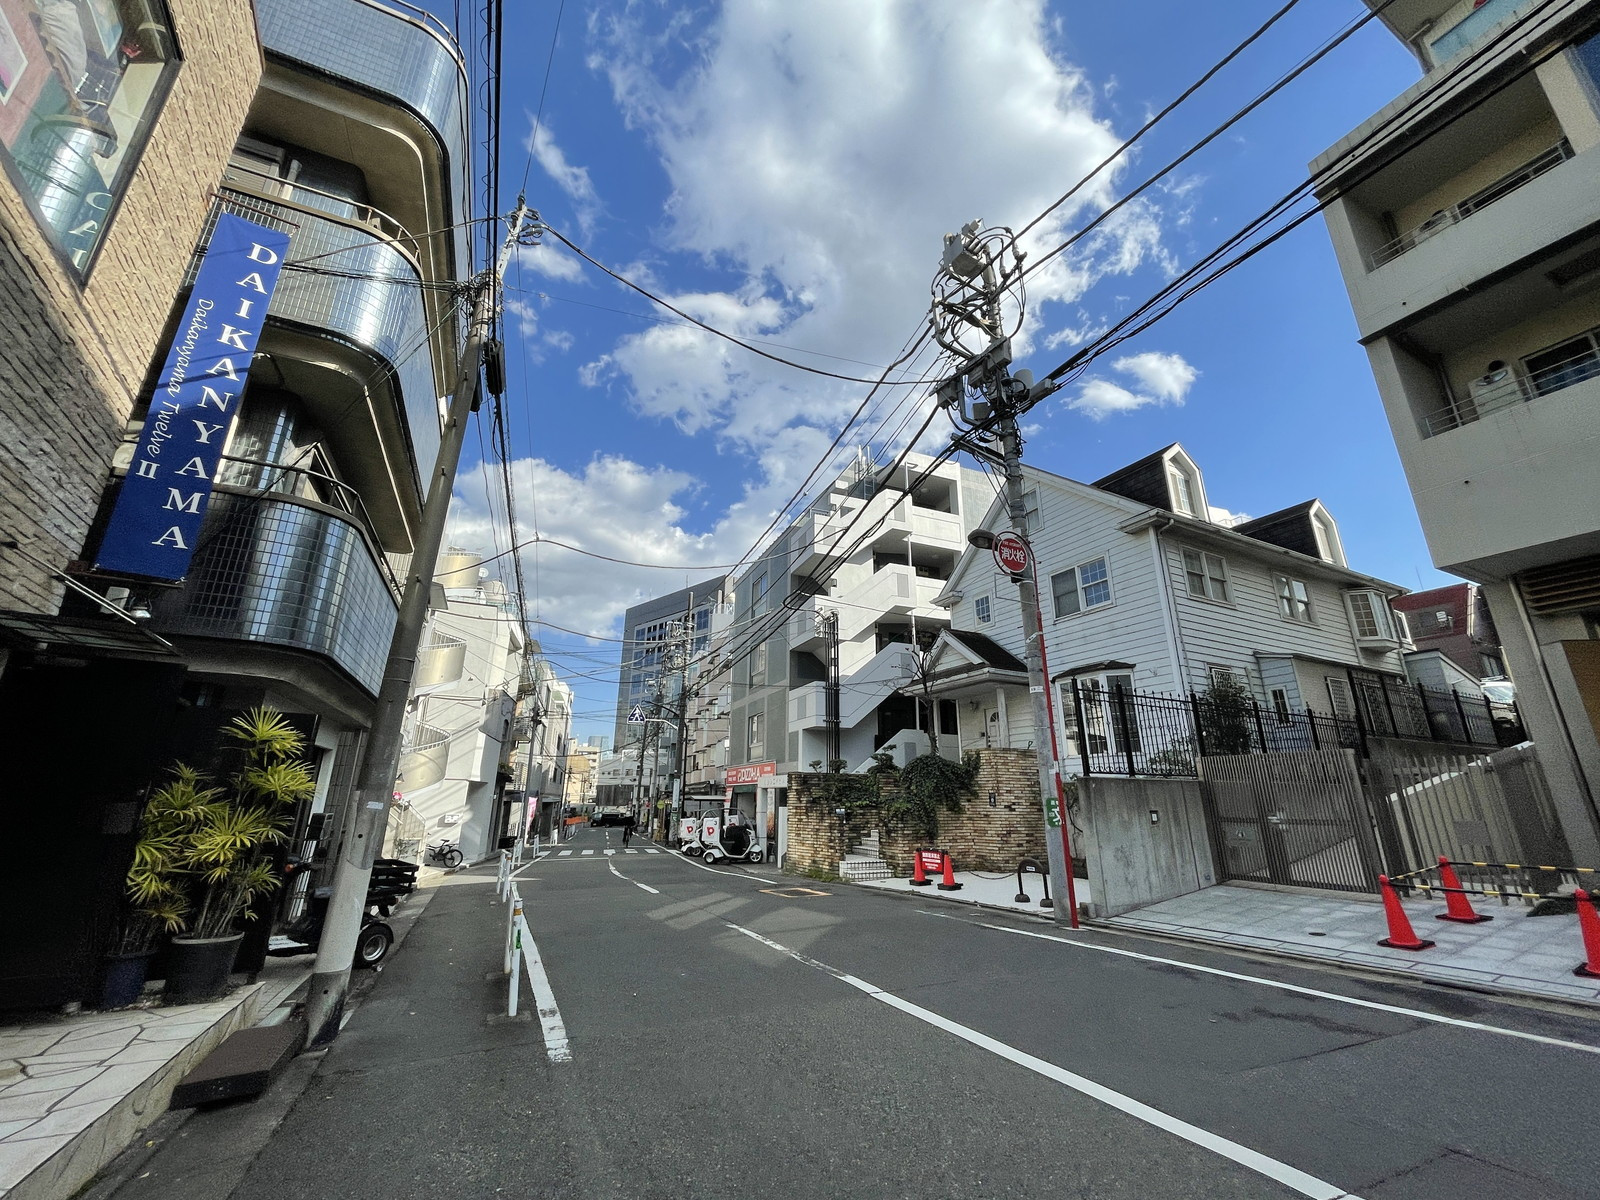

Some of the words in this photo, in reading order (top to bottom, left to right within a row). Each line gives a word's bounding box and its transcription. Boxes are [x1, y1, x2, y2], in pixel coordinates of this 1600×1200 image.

[167, 298, 214, 399] Daikanyama
[147, 400, 181, 457] Twelve
[151, 242, 278, 550] DAIKANYAMA
[1001, 546, 1025, 563] 消火栓
